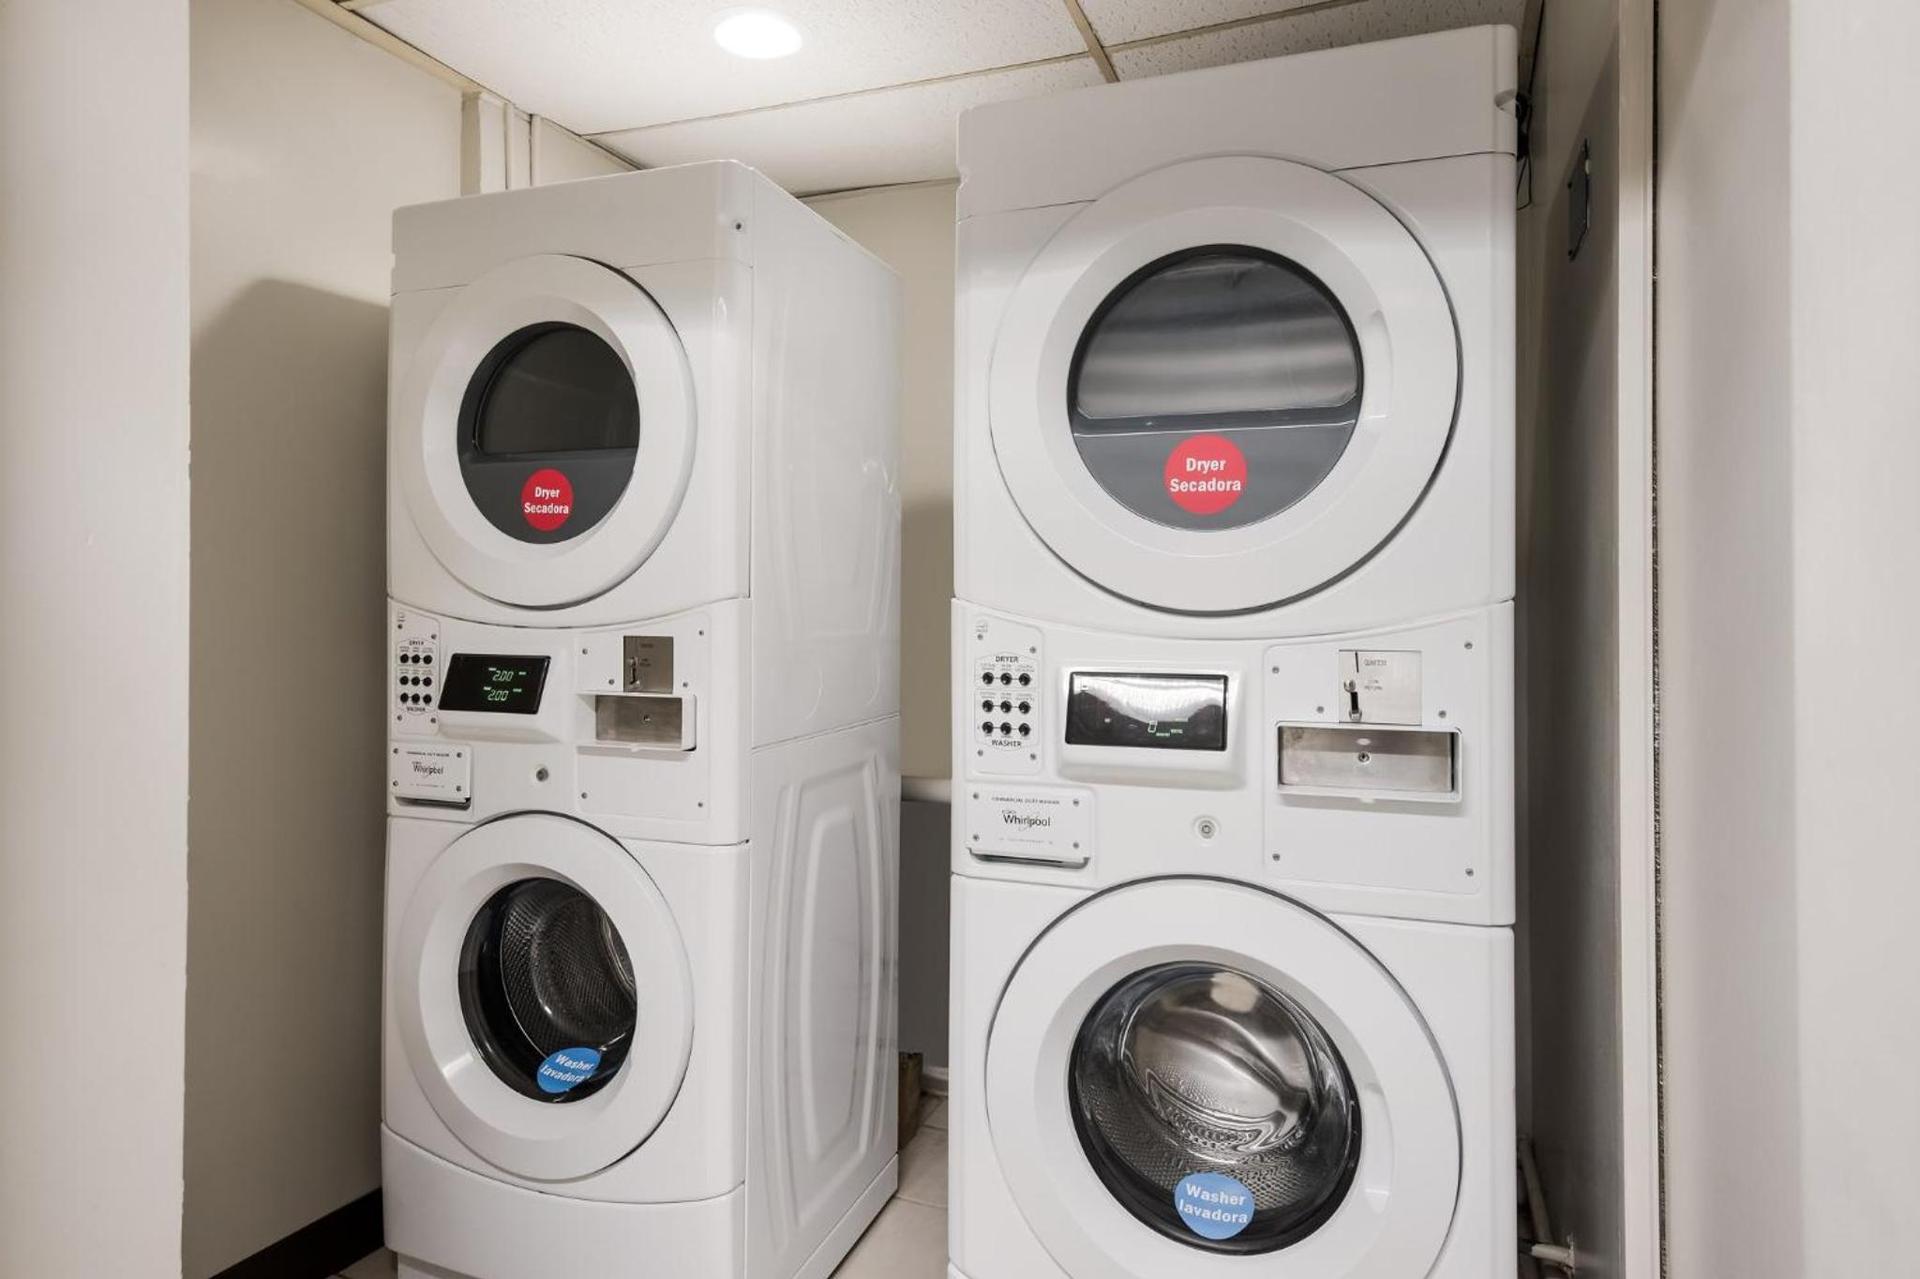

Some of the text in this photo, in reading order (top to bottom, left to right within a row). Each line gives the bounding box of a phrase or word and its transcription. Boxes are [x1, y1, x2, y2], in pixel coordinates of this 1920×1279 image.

[1185, 457, 1227, 474] Dryer
[535, 486, 560, 500] Dryer
[1169, 477, 1242, 493] Secadora
[524, 502, 569, 514] Secadora
[1003, 814, 1051, 828] Whirlpool
[555, 1054, 594, 1071] Washer
[1186, 1183, 1246, 1206] Washer
[1179, 1199, 1248, 1223] lavadora
